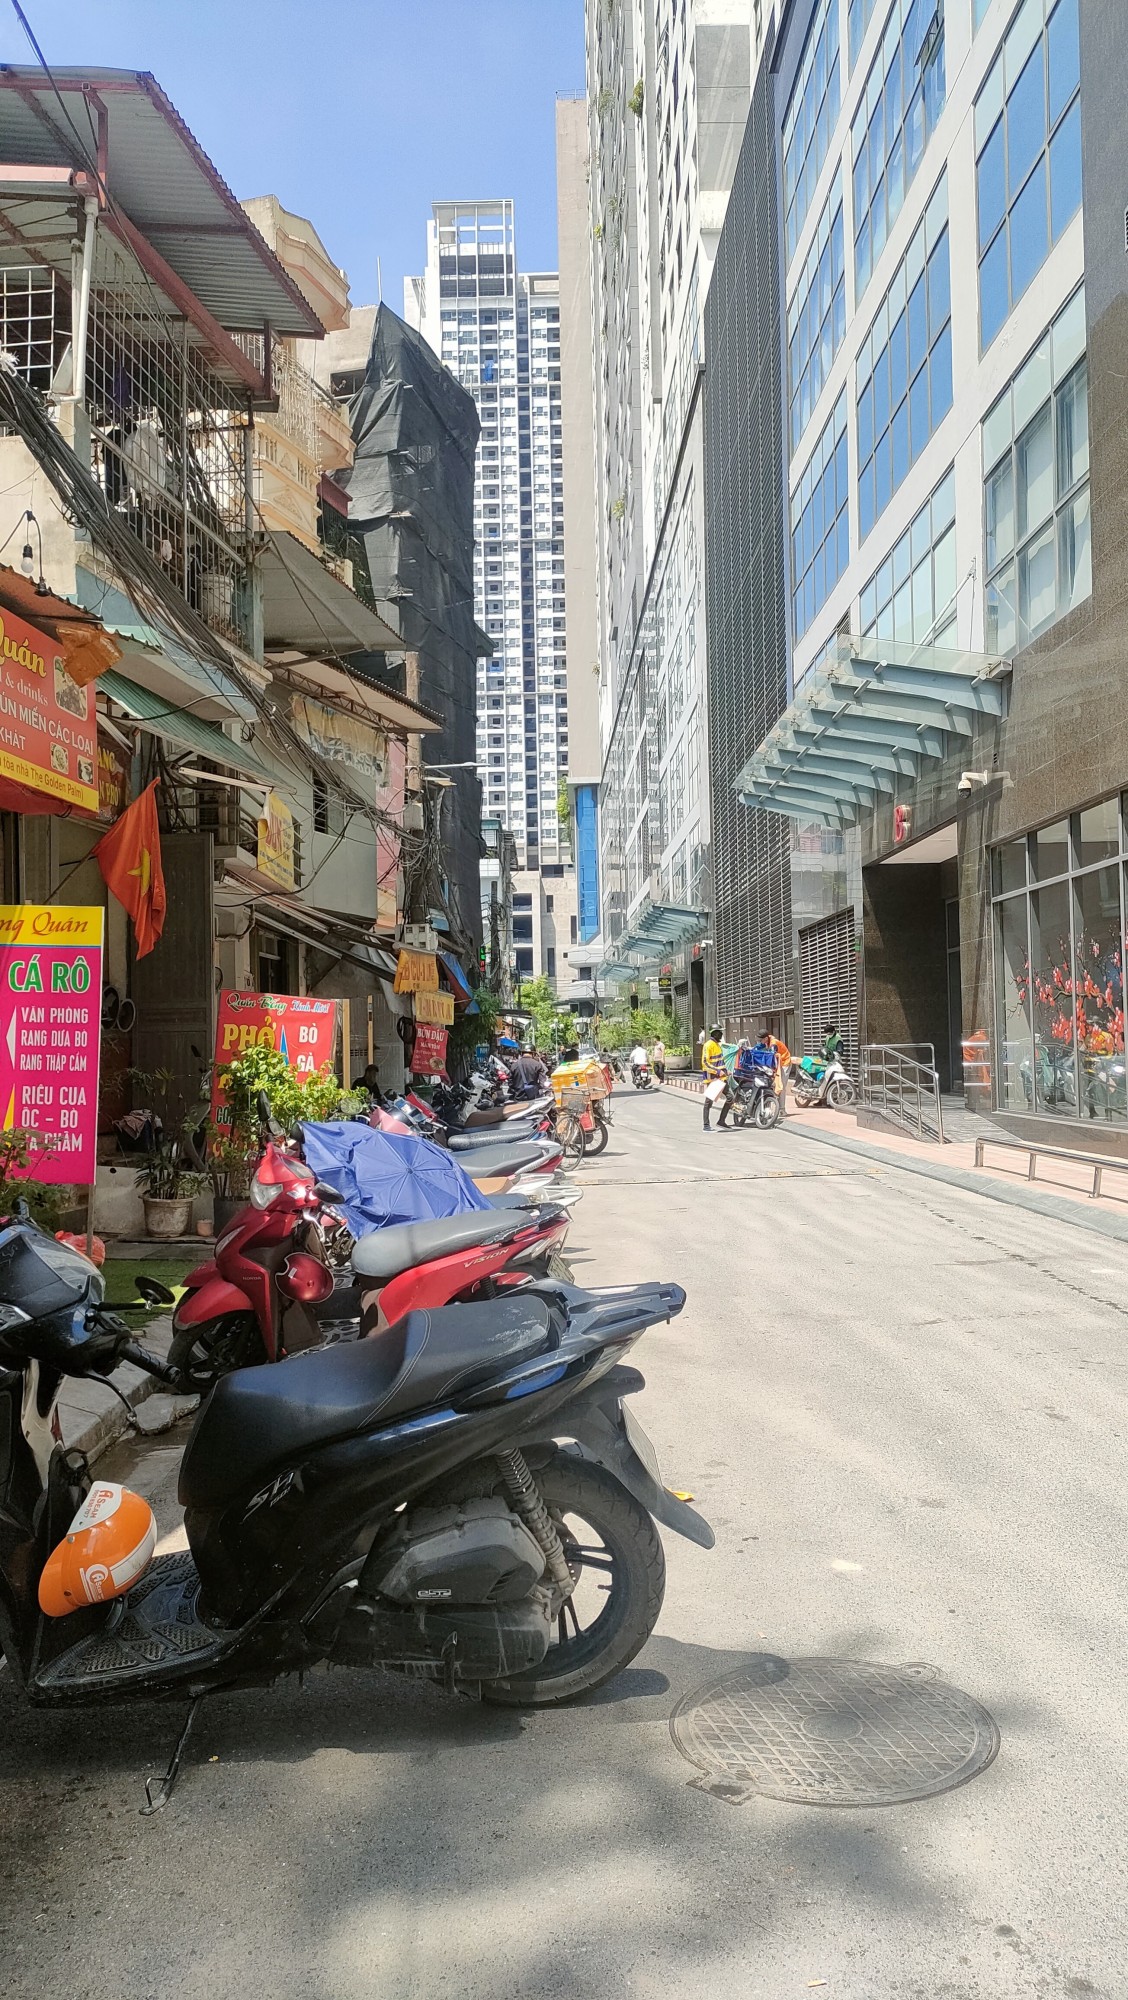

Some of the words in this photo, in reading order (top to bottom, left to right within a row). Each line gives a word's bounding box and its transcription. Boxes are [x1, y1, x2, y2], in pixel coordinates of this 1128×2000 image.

[5, 671, 14, 689] &
[17, 678, 48, 706] drinks
[49, 720, 70, 744] CÁC
[71, 731, 93, 758] LOẠI
[31, 767, 43, 783] The
[44, 773, 66, 792] Golden
[32, 911, 89, 936] Quán
[8, 953, 44, 993] CÁ
[50, 955, 91, 994] RÔ
[21, 1005, 45, 1023] VĂN
[50, 1006, 89, 1024] PHÒNG
[21, 1029, 47, 1047] RANG
[74, 1028, 88, 1048] BÒ
[222, 1016, 277, 1051] PHỞ
[298, 1023, 318, 1044] BÒ
[20, 1053, 42, 1071] RANG
[46, 1052, 67, 1074] THẬP
[297, 1052, 315, 1072] GÀ
[22, 1084, 53, 1105] RIÊU
[60, 1086, 87, 1106] CUA
[60, 1108, 78, 1128] BÒ
[464, 1247, 509, 1269] VISION
